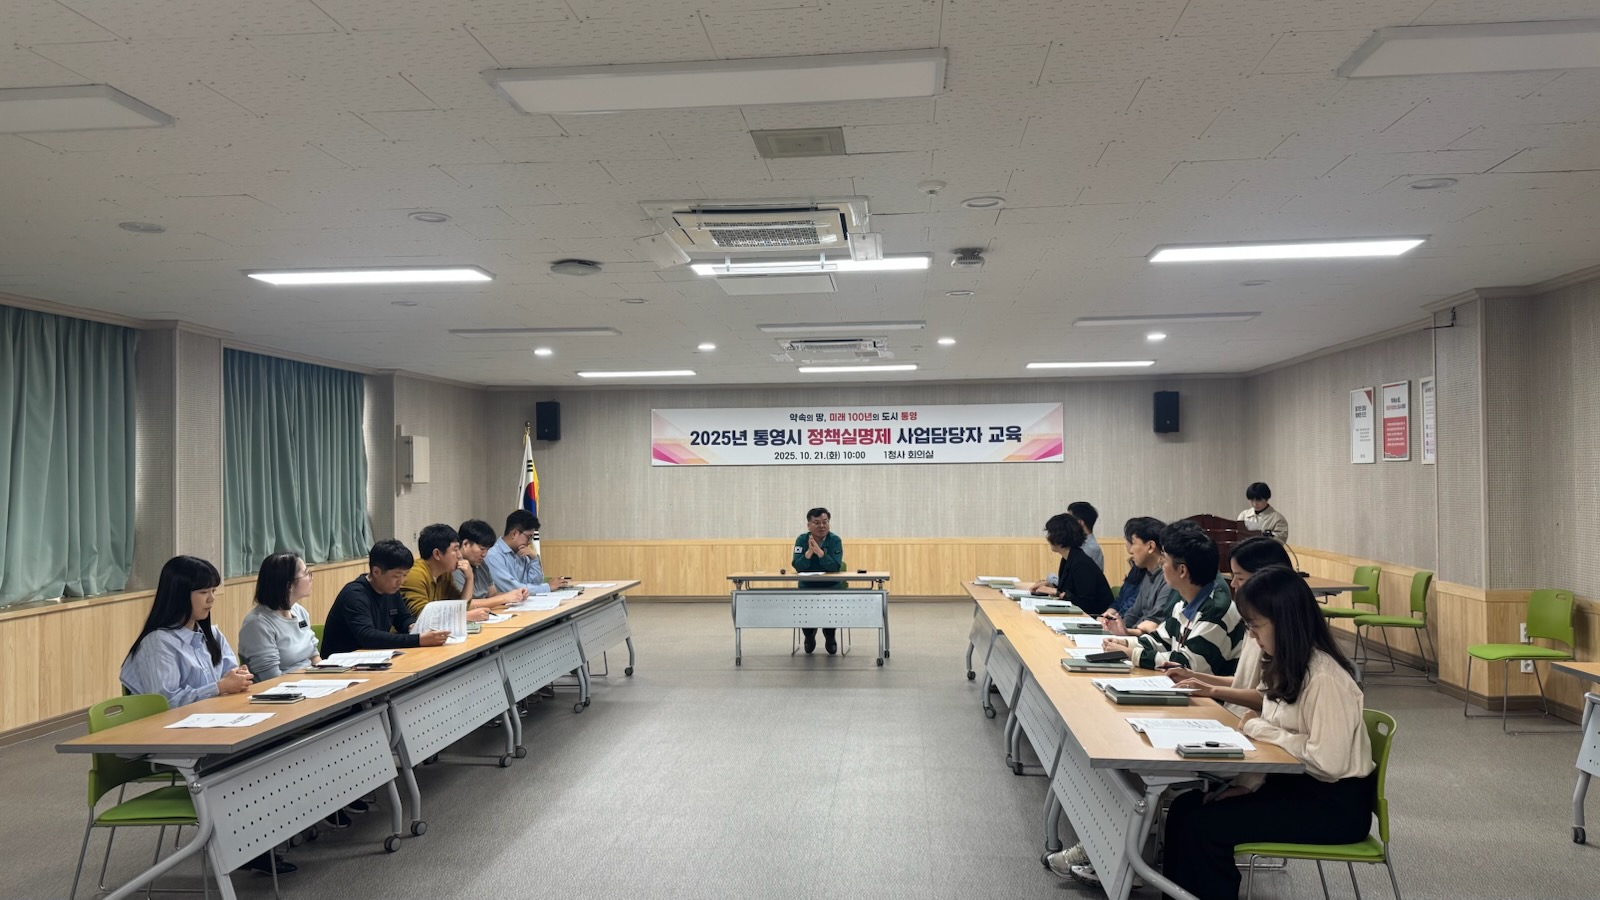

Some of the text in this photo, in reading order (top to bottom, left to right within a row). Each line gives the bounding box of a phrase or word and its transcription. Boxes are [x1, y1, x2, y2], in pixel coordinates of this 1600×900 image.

[789, 411, 918, 422] 약속의 땅, 미래 100년의 도시 통영
[690, 425, 1022, 446] 2025년 통영시 정책실명제 사업담당자 교육
[774, 451, 866, 460] 2025. 10. 21.(화) 10:00
[884, 449, 934, 459] 1청사 회의실
